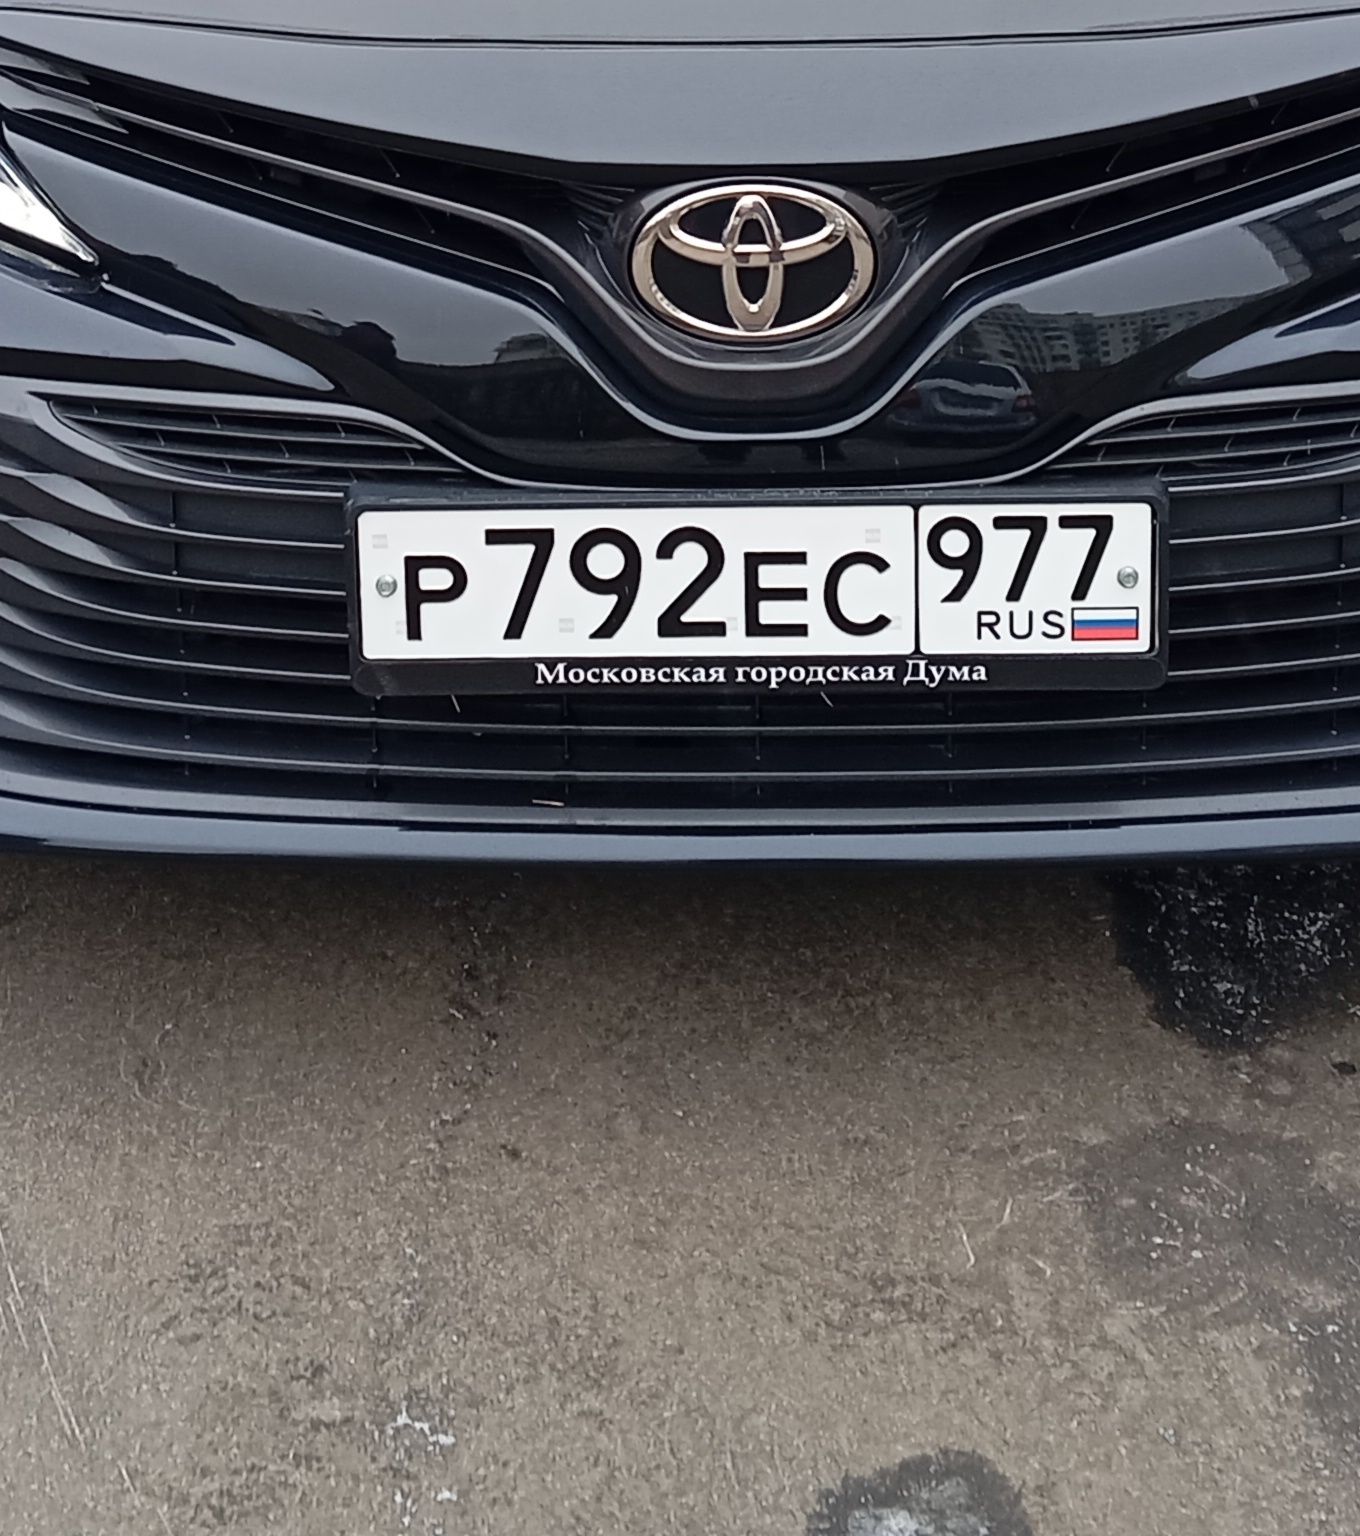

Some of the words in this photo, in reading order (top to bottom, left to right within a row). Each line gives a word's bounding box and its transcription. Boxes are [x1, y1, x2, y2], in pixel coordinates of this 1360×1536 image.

[403, 525, 892, 641] Р792ЕС
[926, 514, 1115, 603] 977
[977, 610, 1066, 640] RUS
[535, 662, 726, 684] Московская
[735, 663, 895, 689] городская
[903, 659, 988, 689] Дума
